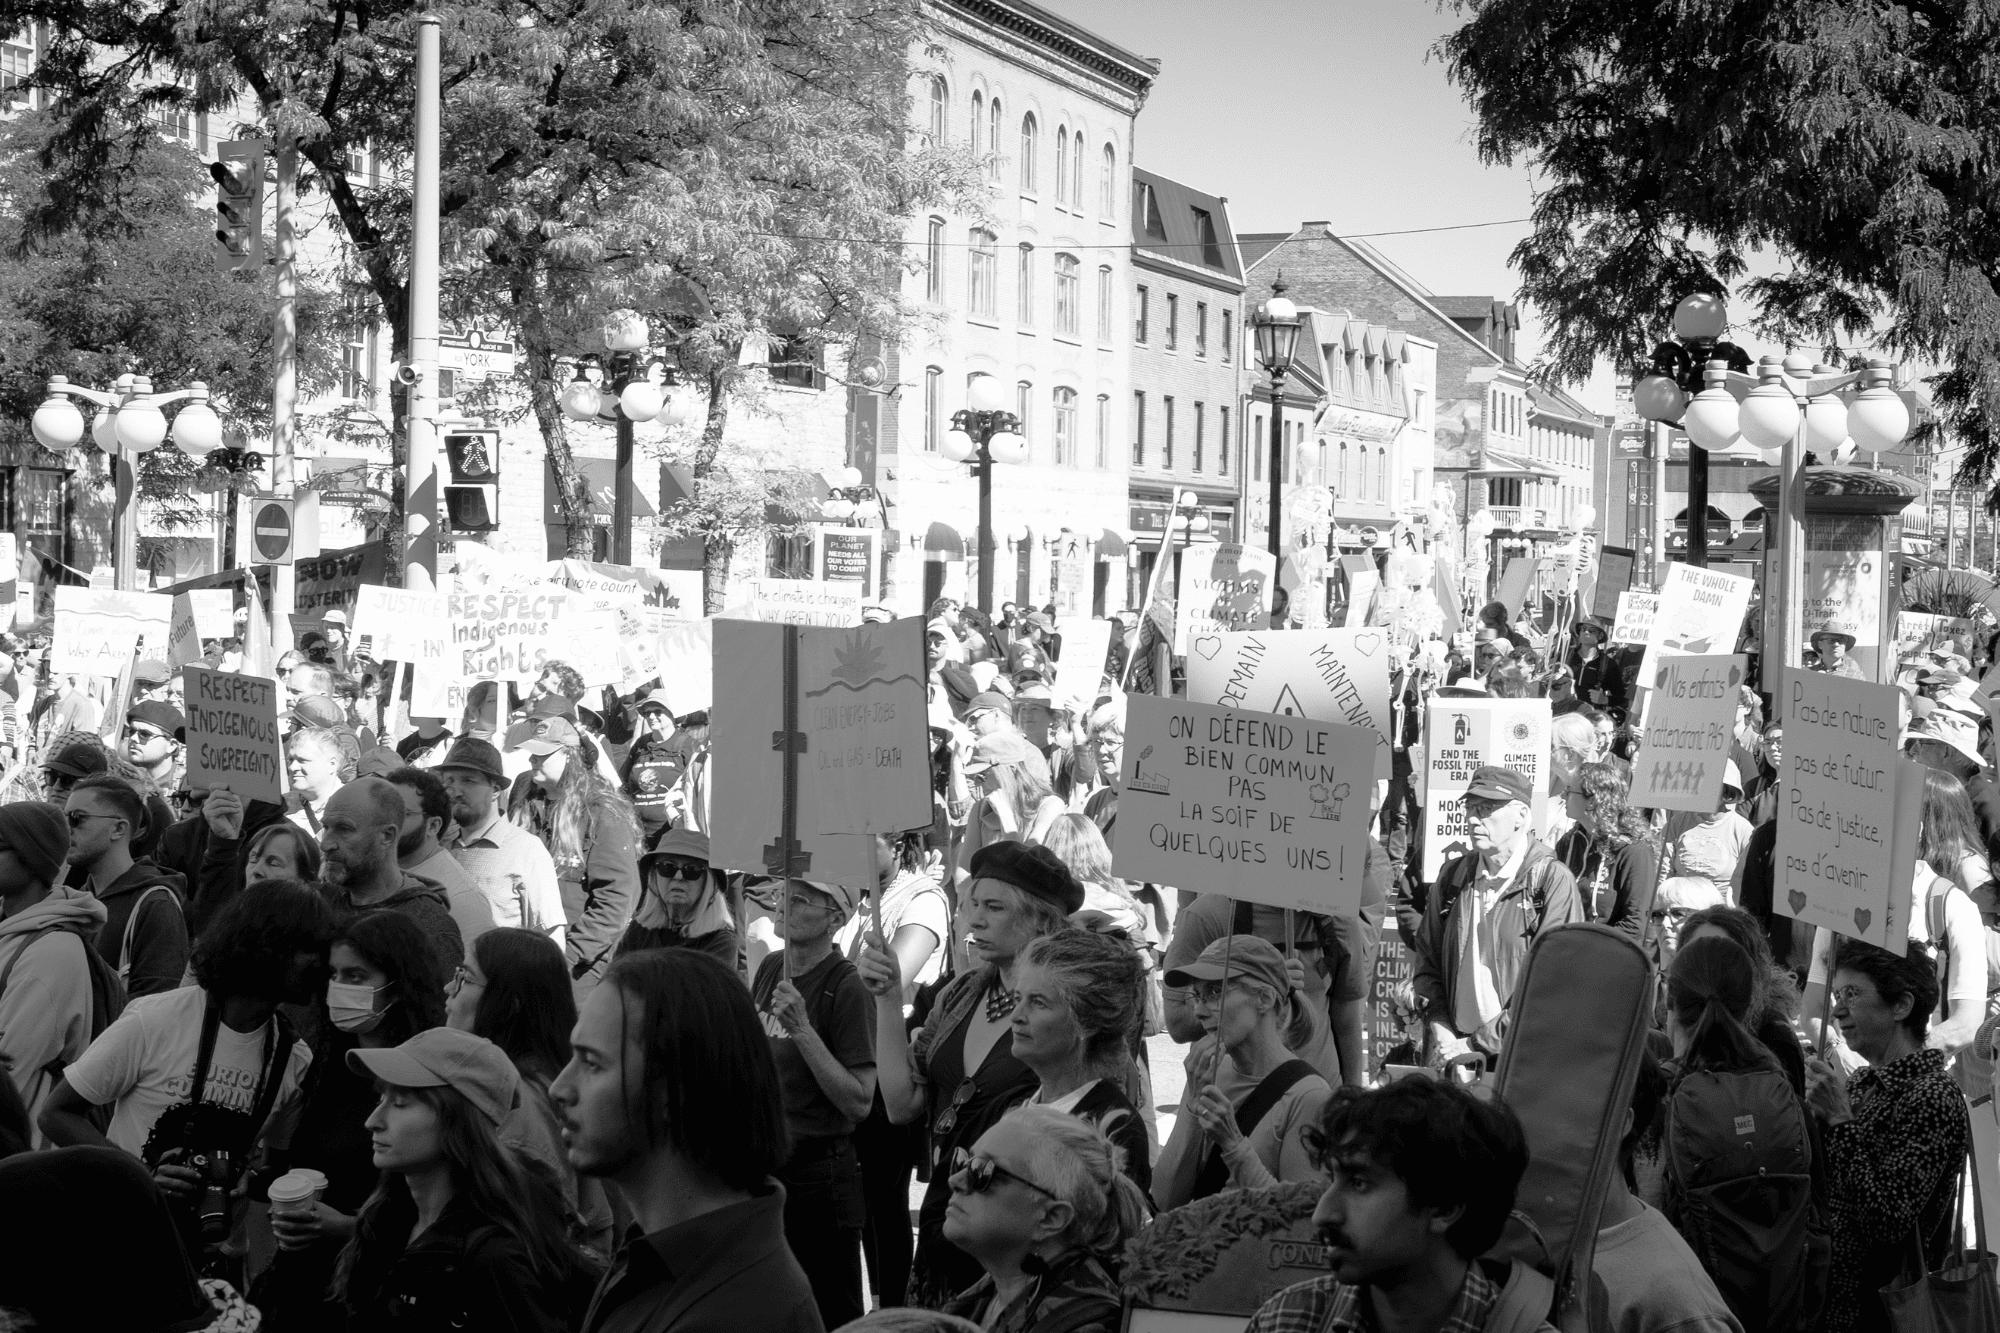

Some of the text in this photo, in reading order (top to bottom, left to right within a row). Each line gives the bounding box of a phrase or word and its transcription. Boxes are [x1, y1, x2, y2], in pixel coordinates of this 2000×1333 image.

[463, 352, 490, 367] YORK
[830, 541, 865, 550] PLANET
[838, 535, 857, 543] OUR
[827, 557, 867, 566] OUR VOTES
[828, 550, 867, 559] NEEDS ALL
[600, 582, 637, 594] count
[750, 582, 768, 600] The
[771, 581, 805, 604] climate
[806, 591, 815, 605] is
[1193, 578, 1259, 594] VICTIMS
[1681, 569, 1737, 593] THE WHOLE
[447, 594, 568, 620] RESPECT
[1693, 589, 1724, 607] DAMN
[1811, 598, 1821, 607] to
[1825, 597, 1842, 607] the
[758, 608, 781, 622] WHY
[1190, 607, 1259, 624] CLIMATE
[452, 619, 549, 651] Indigenous
[462, 642, 548, 680] Rights
[200, 673, 270, 705] RESPECT
[1667, 664, 1725, 698] Nos enfants
[188, 704, 274, 744] INDIGENOUS
[1791, 680, 1891, 746] Pas de nature,
[1169, 713, 1329, 756] ON DÉFEND LE
[1706, 721, 1725, 751] PAS
[200, 742, 276, 784] SOVEREIGNTY
[847, 746, 864, 768] GAS
[875, 746, 902, 768] DEATH
[1432, 760, 1462, 771] FOSSIL
[1440, 749, 1480, 760] END THE
[1504, 753, 1537, 763] CLIMATE
[1244, 752, 1334, 783] COMMUN
[1450, 771, 1469, 781] ERA
[1794, 753, 1885, 792] pas de futur.
[1228, 775, 1266, 801] PAS
[1179, 800, 1203, 820] LA
[1269, 811, 1294, 834] DE
[1790, 787, 1884, 849] Pas de justice,
[1149, 823, 1267, 863] QUELQUES
[1785, 854, 1807, 885] pas
[1379, 941, 1406, 959] THE
[1376, 1000, 1389, 1018] IS
